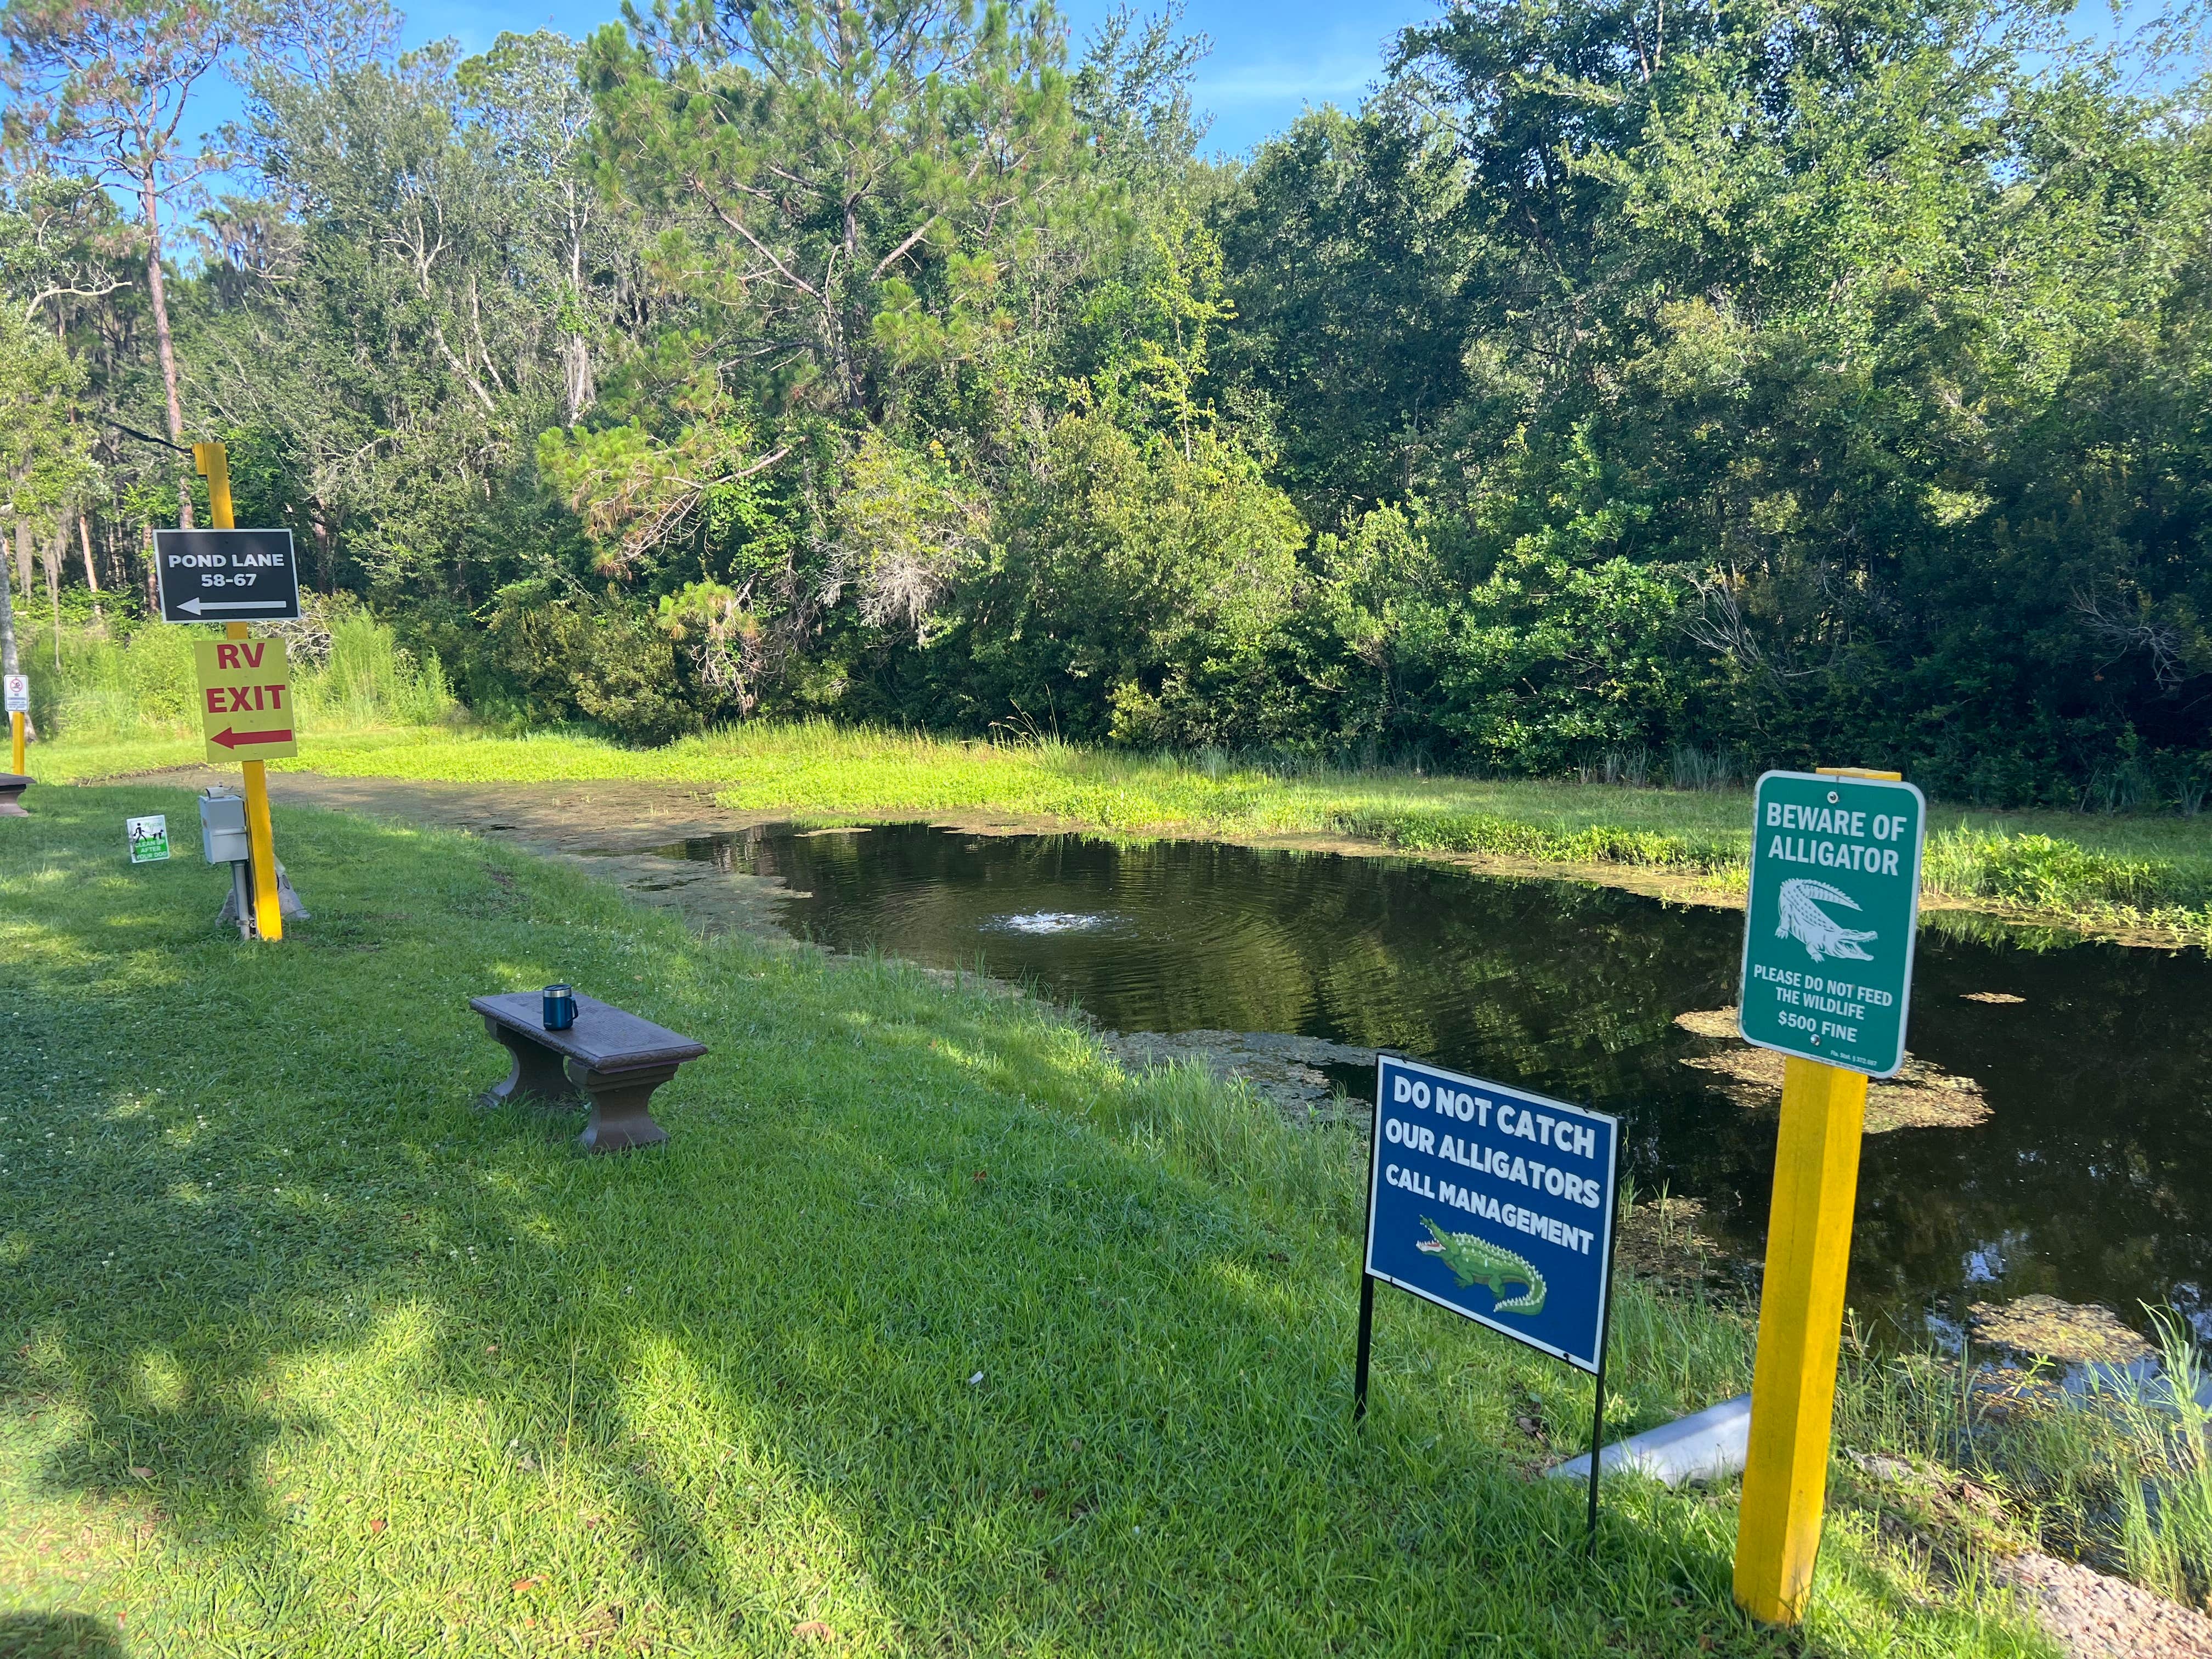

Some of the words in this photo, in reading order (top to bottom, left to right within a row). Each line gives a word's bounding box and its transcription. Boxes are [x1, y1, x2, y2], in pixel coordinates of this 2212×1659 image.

[168, 554, 227, 568] POND
[232, 554, 285, 567] LANE
[201, 573, 257, 587] 58-67
[217, 642, 265, 669] RV
[206, 684, 286, 713] EXIT
[1766, 802, 1866, 837] BEWARE
[1872, 814, 1908, 842] OF
[1768, 835, 1899, 876] ALLIGATOR
[1753, 964, 1802, 988] PLEASE
[1804, 975, 1824, 991] DO
[1827, 980, 1853, 998] NOT
[1857, 986, 1893, 1007] FEED
[1775, 986, 1801, 1005] THE
[1803, 992, 1865, 1020] WILDLIFE
[1778, 1010, 1816, 1032] $500
[1821, 1021, 1858, 1043] FINE
[1394, 1075, 1431, 1109] DO
[1436, 1086, 1492, 1127] NOT
[1497, 1105, 1595, 1159] CATCH
[1385, 1118, 1435, 1155] OUR
[1438, 1134, 1600, 1209] ALLIGATORS
[1386, 1164, 1435, 1199] CALL
[1438, 1180, 1594, 1255] MANAGEMENT
